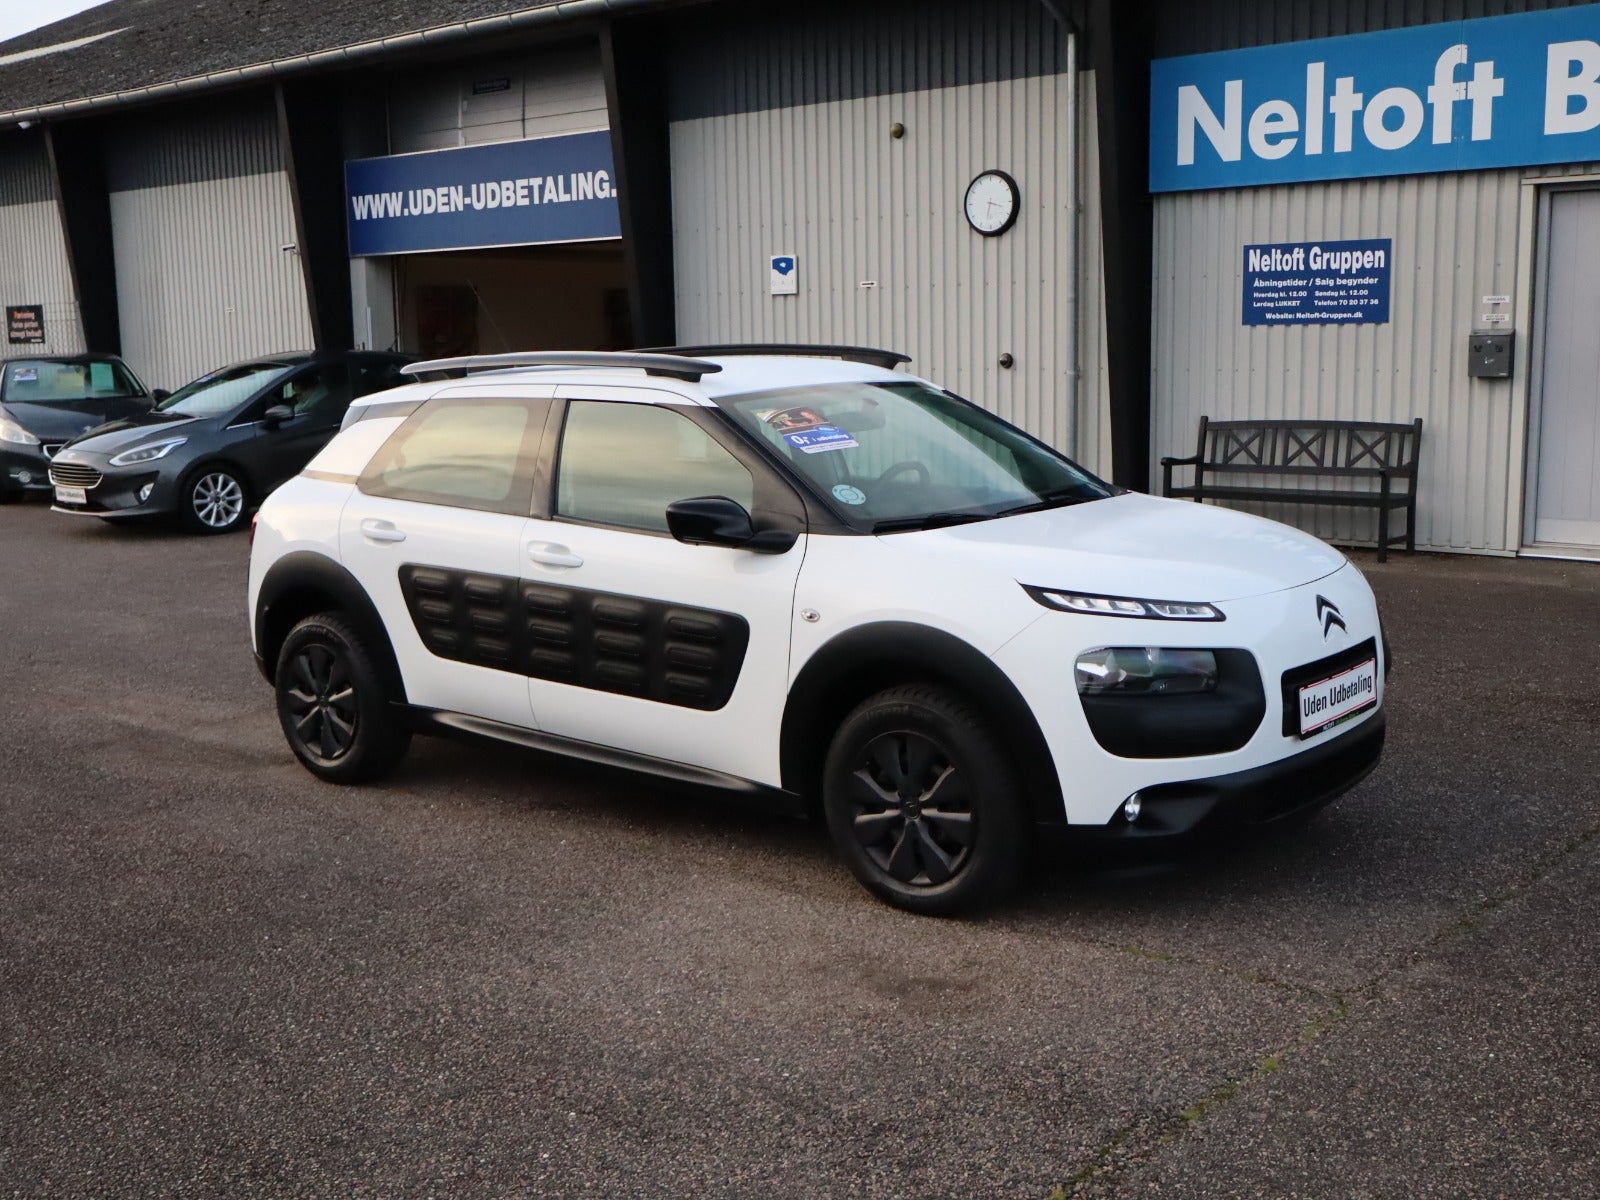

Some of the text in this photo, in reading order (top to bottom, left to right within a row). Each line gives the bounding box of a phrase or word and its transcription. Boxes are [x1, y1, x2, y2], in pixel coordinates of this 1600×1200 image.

[1177, 40, 1600, 166] Neltoft B
[352, 170, 617, 220] WWW.UDEN-UDBETALING.
[1249, 246, 1385, 274] Neltoft Gruppen
[1253, 277, 1379, 288] Åbningstider / Salg begynder
[1303, 674, 1372, 717] Uden Udbetaling
